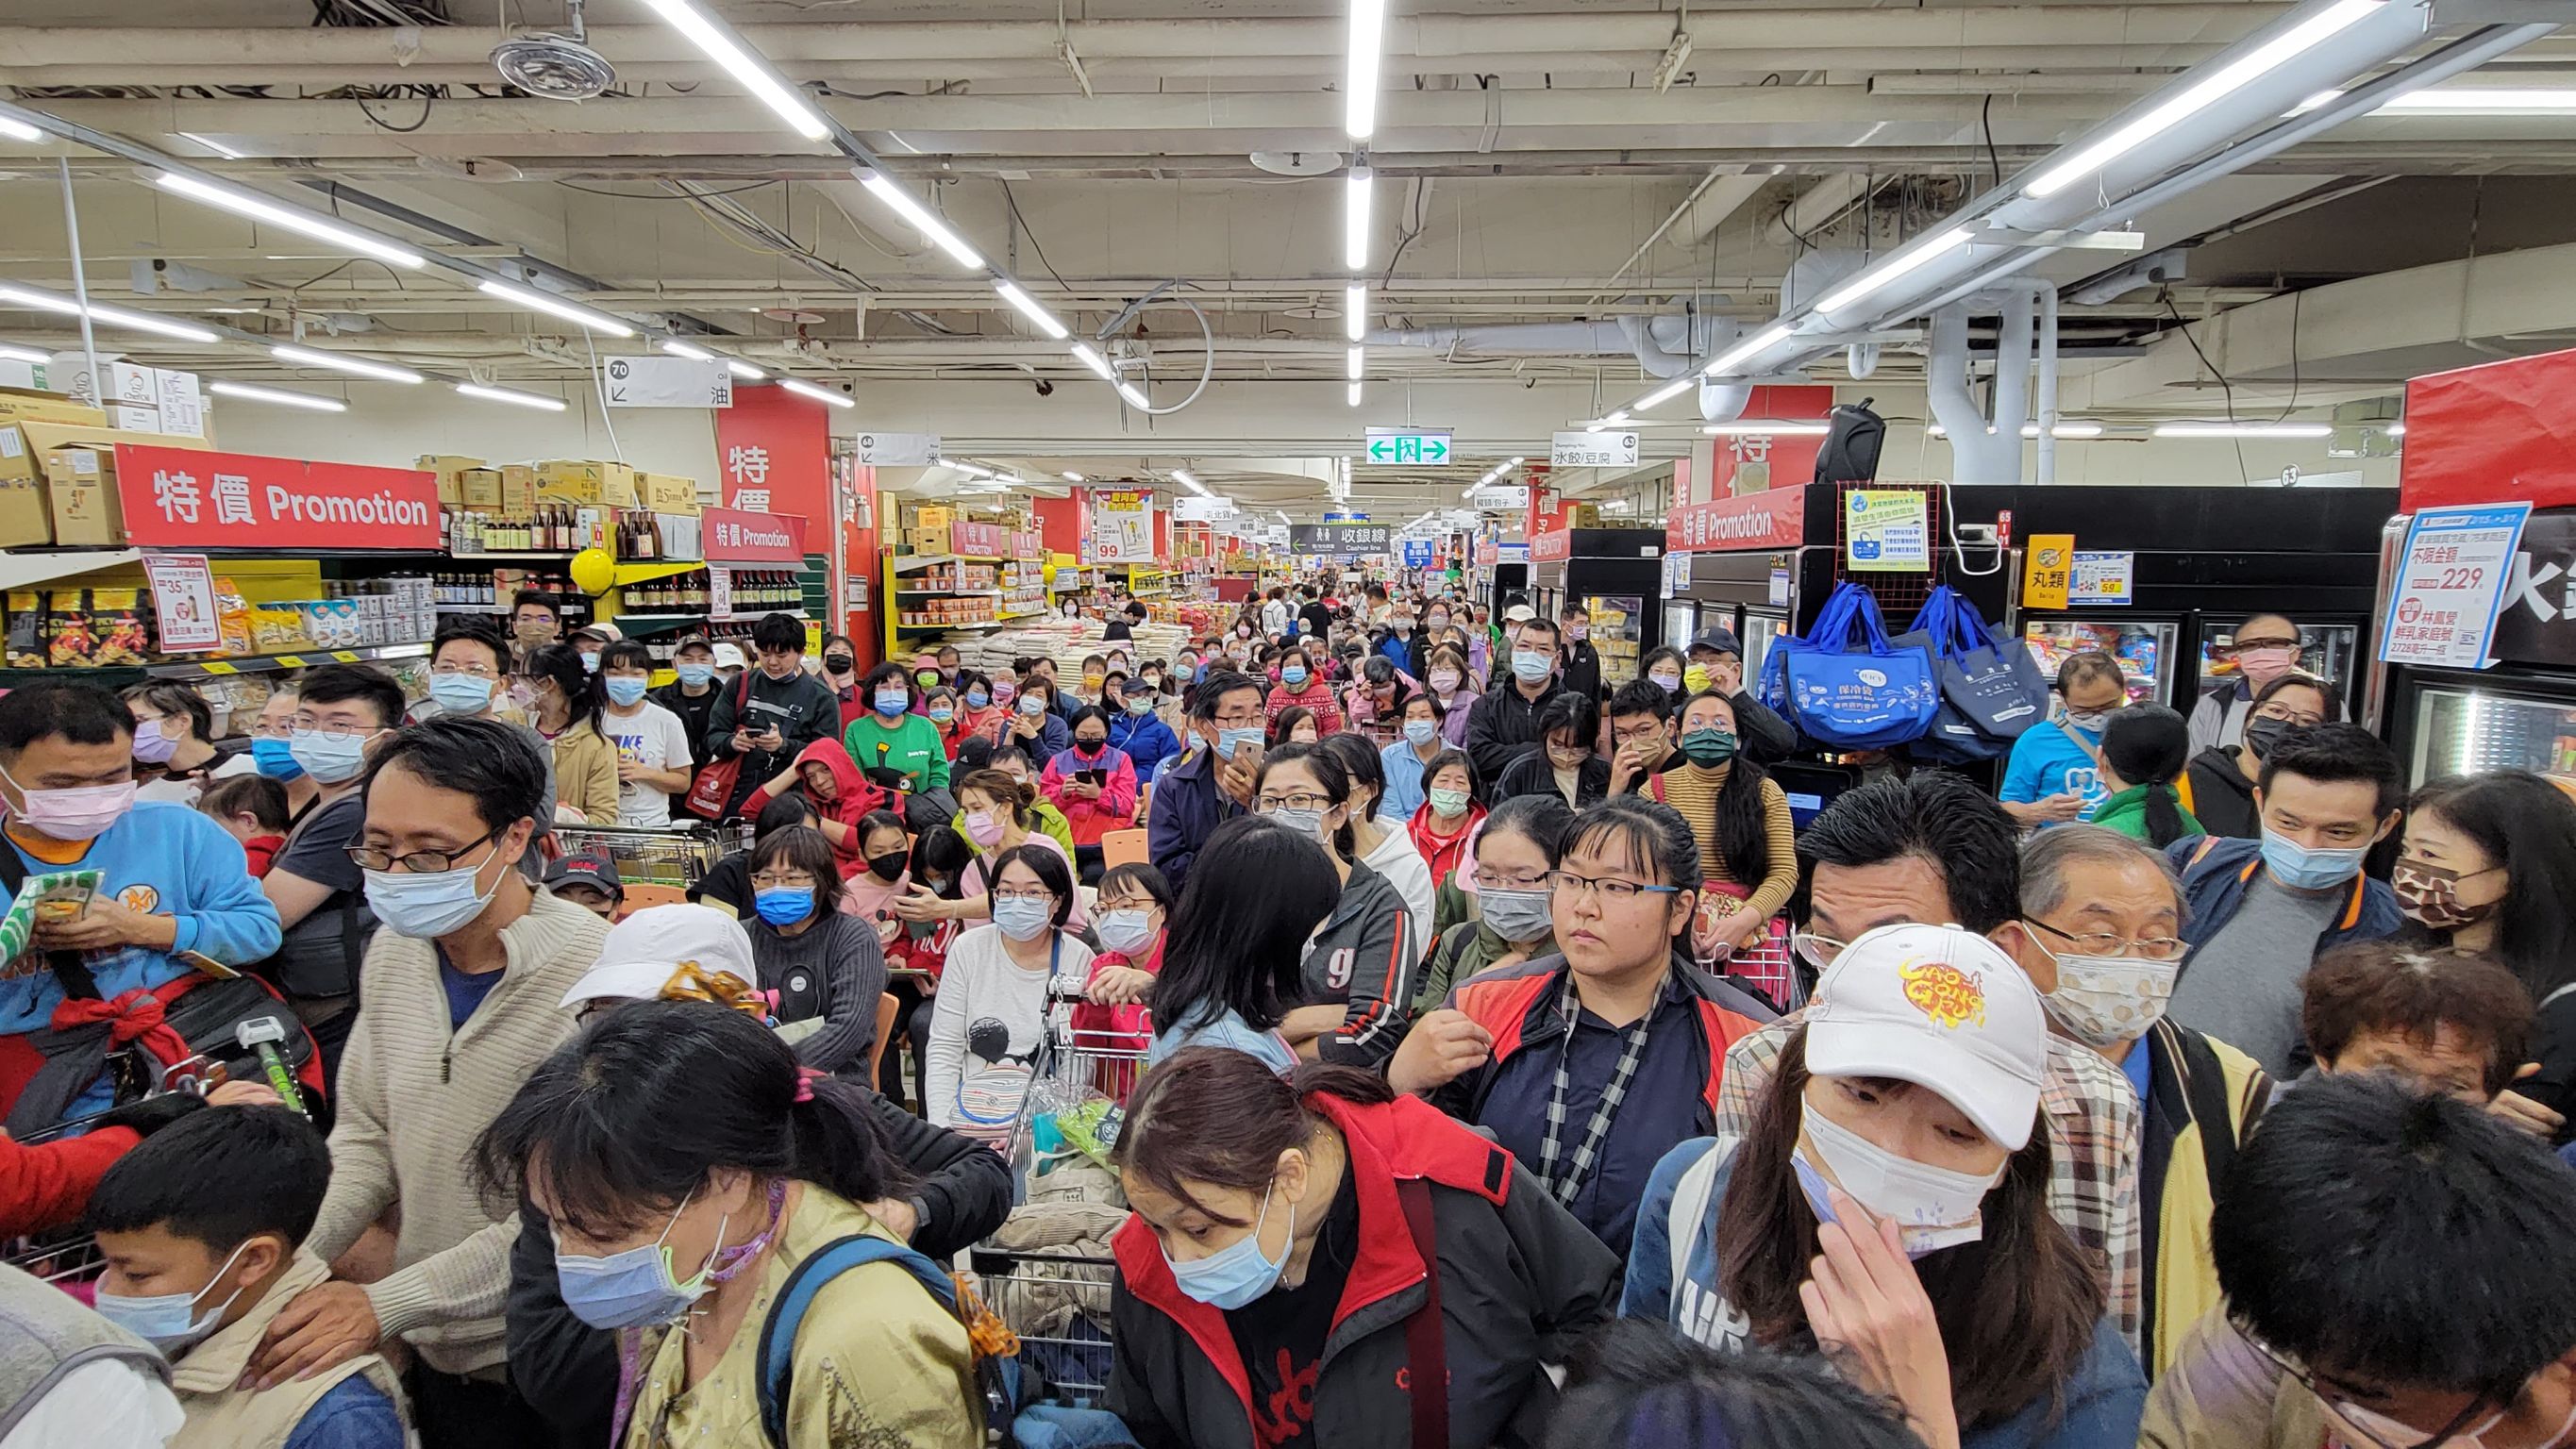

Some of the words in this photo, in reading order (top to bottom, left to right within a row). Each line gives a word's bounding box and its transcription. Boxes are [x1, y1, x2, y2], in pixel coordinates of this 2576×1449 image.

[612, 365, 628, 375] 70
[711, 386, 728, 405] 油
[927, 453, 940, 465] 米
[1554, 452, 1611, 464] 水餃/豆腐
[2283, 467, 2297, 486] 63
[153, 470, 257, 525] 特價
[266, 486, 427, 525] Promotion
[1204, 510, 1230, 520] 南北貨
[1999, 511, 2011, 523] 65
[1682, 508, 1707, 546] 特價
[1709, 505, 1772, 541] Promotion
[716, 523, 741, 547] 特價
[744, 528, 790, 548] Promotion
[1341, 528, 1386, 543] 收銀線
[1099, 544, 1118, 558] 99
[2411, 546, 2459, 564] 不限金額
[167, 580, 182, 593] 35
[2032, 571, 2066, 590] 丸類
[2439, 568, 2484, 590] 229
[2394, 625, 2453, 642] 鮮乳家庭號
[1838, 685, 1873, 696] 保冷袋
